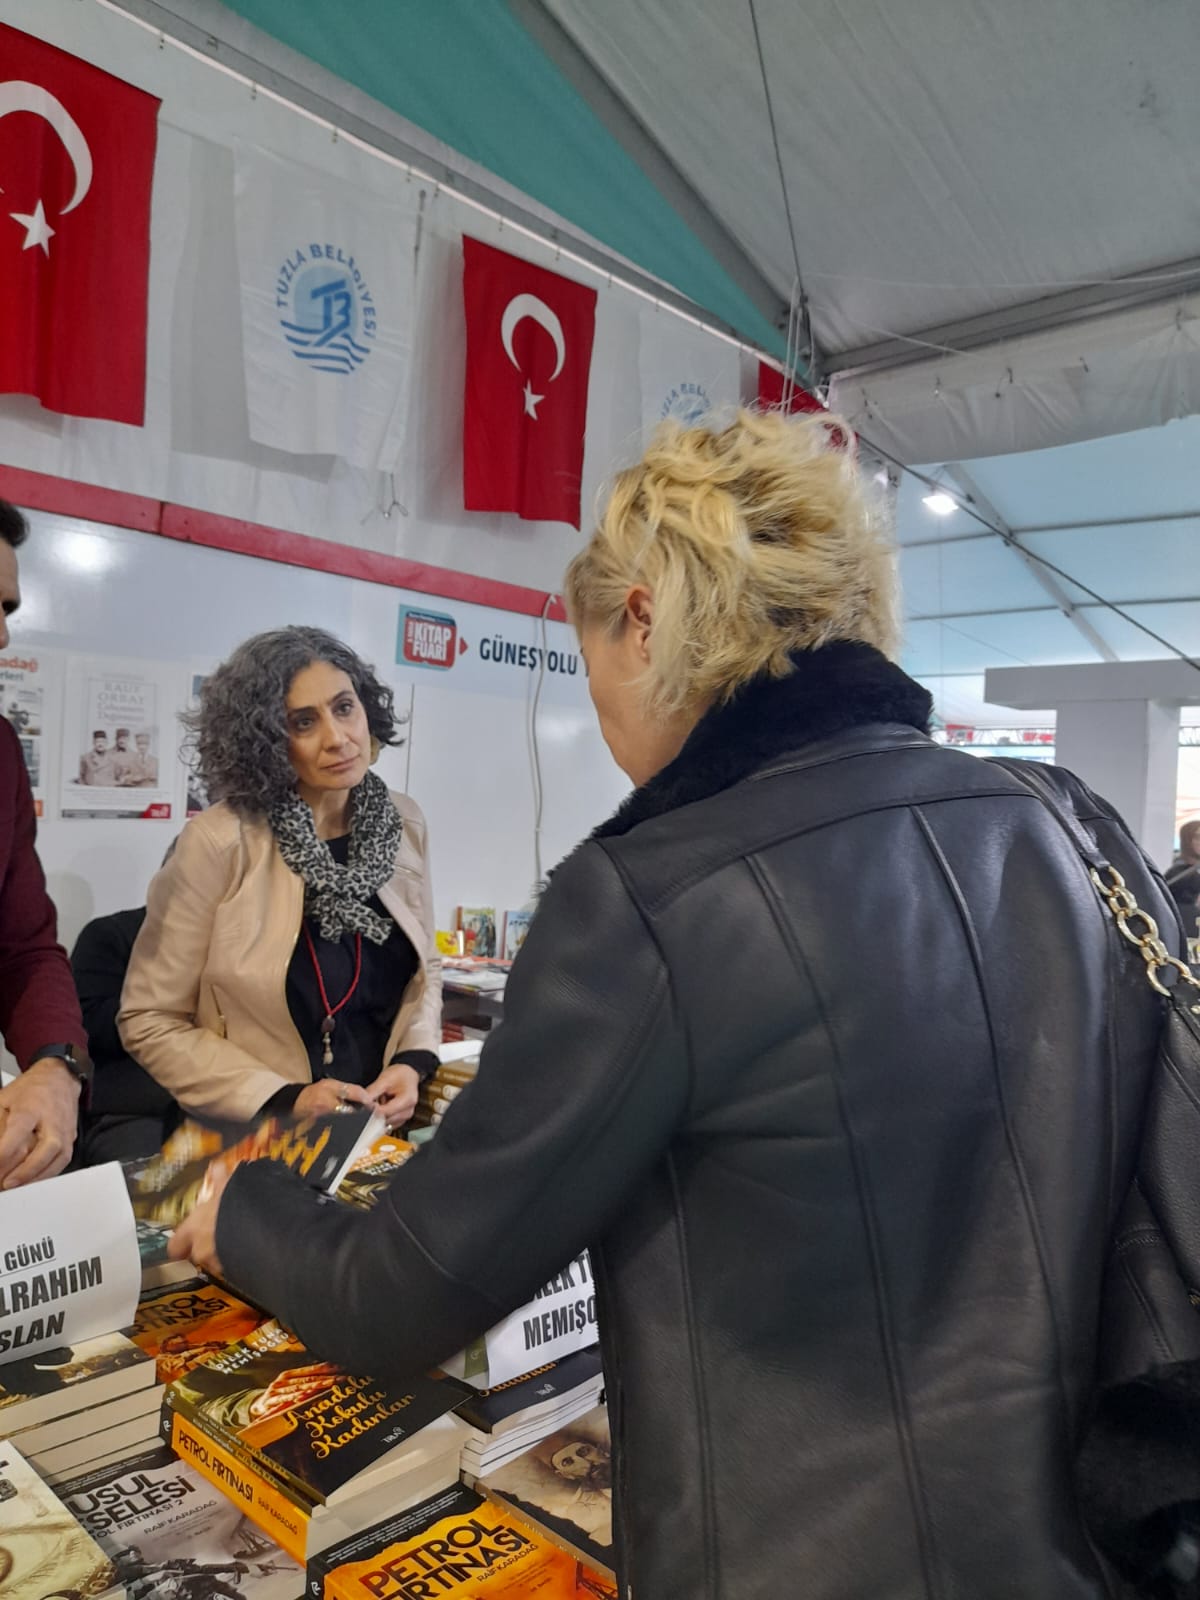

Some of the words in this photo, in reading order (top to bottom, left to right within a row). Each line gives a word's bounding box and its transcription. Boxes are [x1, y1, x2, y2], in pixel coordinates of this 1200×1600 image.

[276, 250, 307, 308] TUZLA
[414, 621, 452, 646] KİTAP
[4, 1235, 55, 1272] GÜNÜ
[305, 1391, 387, 1438] Kokulu
[66, 1474, 166, 1515] USUL
[178, 1429, 210, 1469] PETROL
[212, 1456, 254, 1504] FIRTINASI
[81, 1475, 196, 1534] SELESİ
[358, 1518, 504, 1598] PETROL
[381, 1527, 531, 1600] RTINASI
